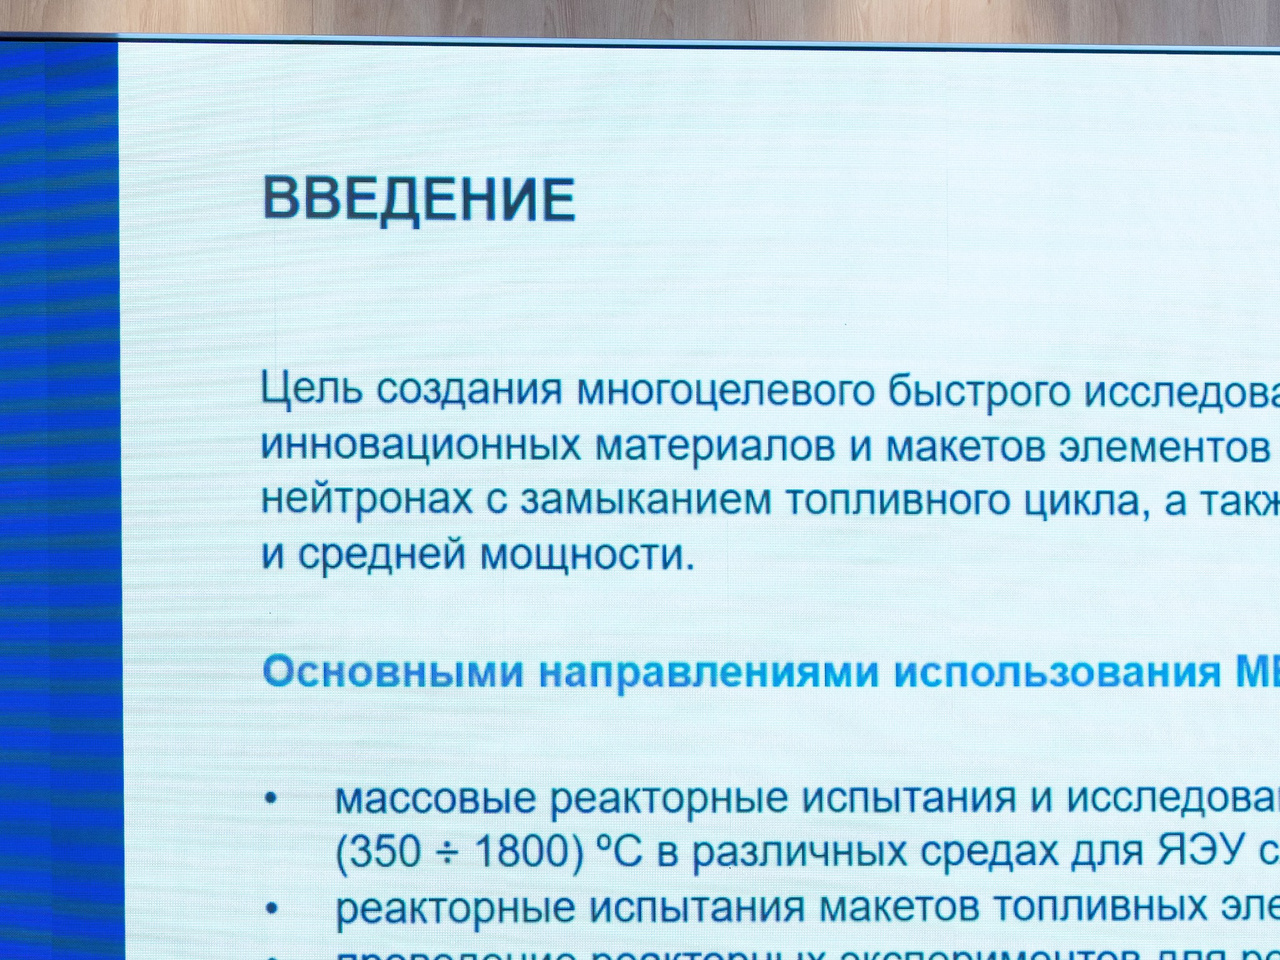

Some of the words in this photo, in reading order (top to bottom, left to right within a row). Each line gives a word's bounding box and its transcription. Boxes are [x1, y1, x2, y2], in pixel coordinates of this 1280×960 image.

[264, 174, 576, 230] ВВЕДЕНИЕ
[262, 369, 363, 413] Цель
[377, 377, 562, 410] создания
[578, 379, 875, 411] многоцелевого
[889, 372, 1071, 416] быстрого
[262, 433, 582, 466] инновационных
[596, 434, 836, 470] материалов
[851, 435, 871, 461] и
[887, 436, 1046, 462] макетов
[1060, 436, 1271, 463] элементов
[262, 480, 473, 523] нейтронах
[487, 488, 508, 514] с
[521, 488, 771, 515] замыканием
[785, 489, 1011, 515] топливного
[1025, 490, 1149, 522] цикла,
[1165, 490, 1187, 516] а
[263, 543, 284, 569] и
[299, 536, 465, 578] средней
[482, 543, 694, 576] мощности.
[263, 653, 523, 687] Основными
[540, 661, 879, 697] направлениями
[895, 661, 1221, 688] использования
[336, 787, 536, 814] массовые
[551, 787, 788, 823] реакторные
[803, 786, 1016, 813] испытания
[1032, 786, 1052, 812] и
[1068, 786, 1280, 818] исследова
[337, 833, 421, 878] (350
[476, 833, 584, 876] 1800)
[658, 841, 679, 867] в
[694, 841, 908, 876] различных
[921, 840, 1058, 876] средах
[1071, 840, 1143, 871] для
[1158, 831, 1246, 865] ЯЭУ
[337, 897, 576, 934] реакторные
[591, 896, 805, 923] испытания
[820, 896, 980, 922] макетов
[993, 895, 1208, 922] топливных
